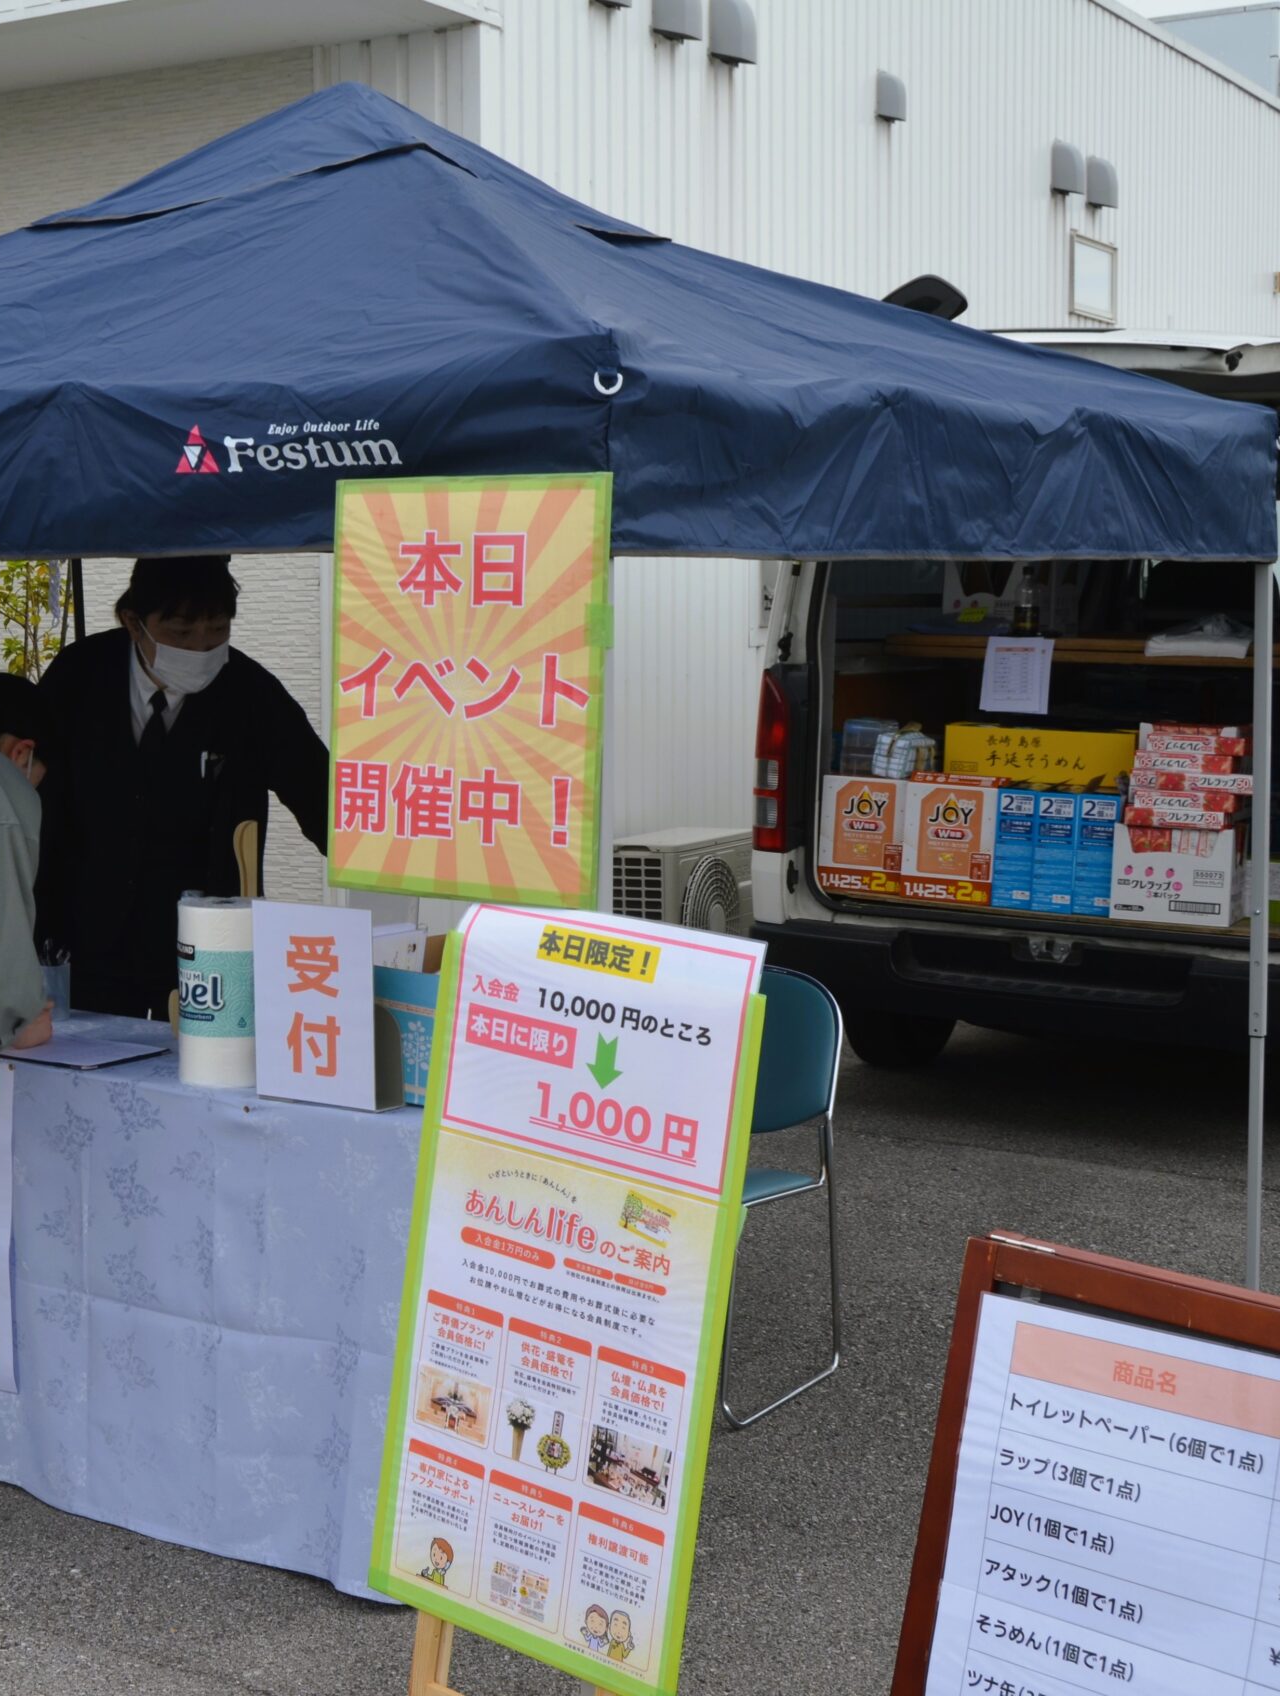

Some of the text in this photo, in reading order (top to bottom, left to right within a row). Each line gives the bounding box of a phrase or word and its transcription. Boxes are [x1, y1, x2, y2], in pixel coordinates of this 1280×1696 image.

[268, 419, 380, 436] Enjoy Outdoor Life
[224, 434, 403, 473] Festum
[399, 529, 527, 608] 本日
[339, 648, 590, 729] イベント
[1200, 777, 1236, 786] クレラップ
[335, 760, 572, 848] 開催中！
[844, 798, 887, 817] JOY
[929, 805, 973, 825] JOY
[1167, 813, 1205, 822] クレラップ
[1131, 880, 1171, 891] クレラップ
[538, 928, 651, 976] 本日限定！
[286, 935, 341, 1078] 受付
[471, 974, 520, 1002] 入会金
[469, 1012, 570, 1058] 本日に限り
[475, 1232, 541, 1262] 入会金1万円のみ
[1113, 1359, 1178, 1396] 商品名
[1010, 1393, 1265, 1474] トイレットペーパー(6個で1点)
[409, 1471, 476, 1506] アフターサポート
[418, 1461, 469, 1490] 専門家による
[999, 1448, 1142, 1503] ラップ(3個で1点)
[492, 1490, 565, 1527] ニュースレターを
[990, 1503, 1115, 1555] JOY(1個で1点)
[984, 1558, 1143, 1624] アタック(1個で1点)
[976, 1614, 1134, 1683] そうめん(1個で1点)
